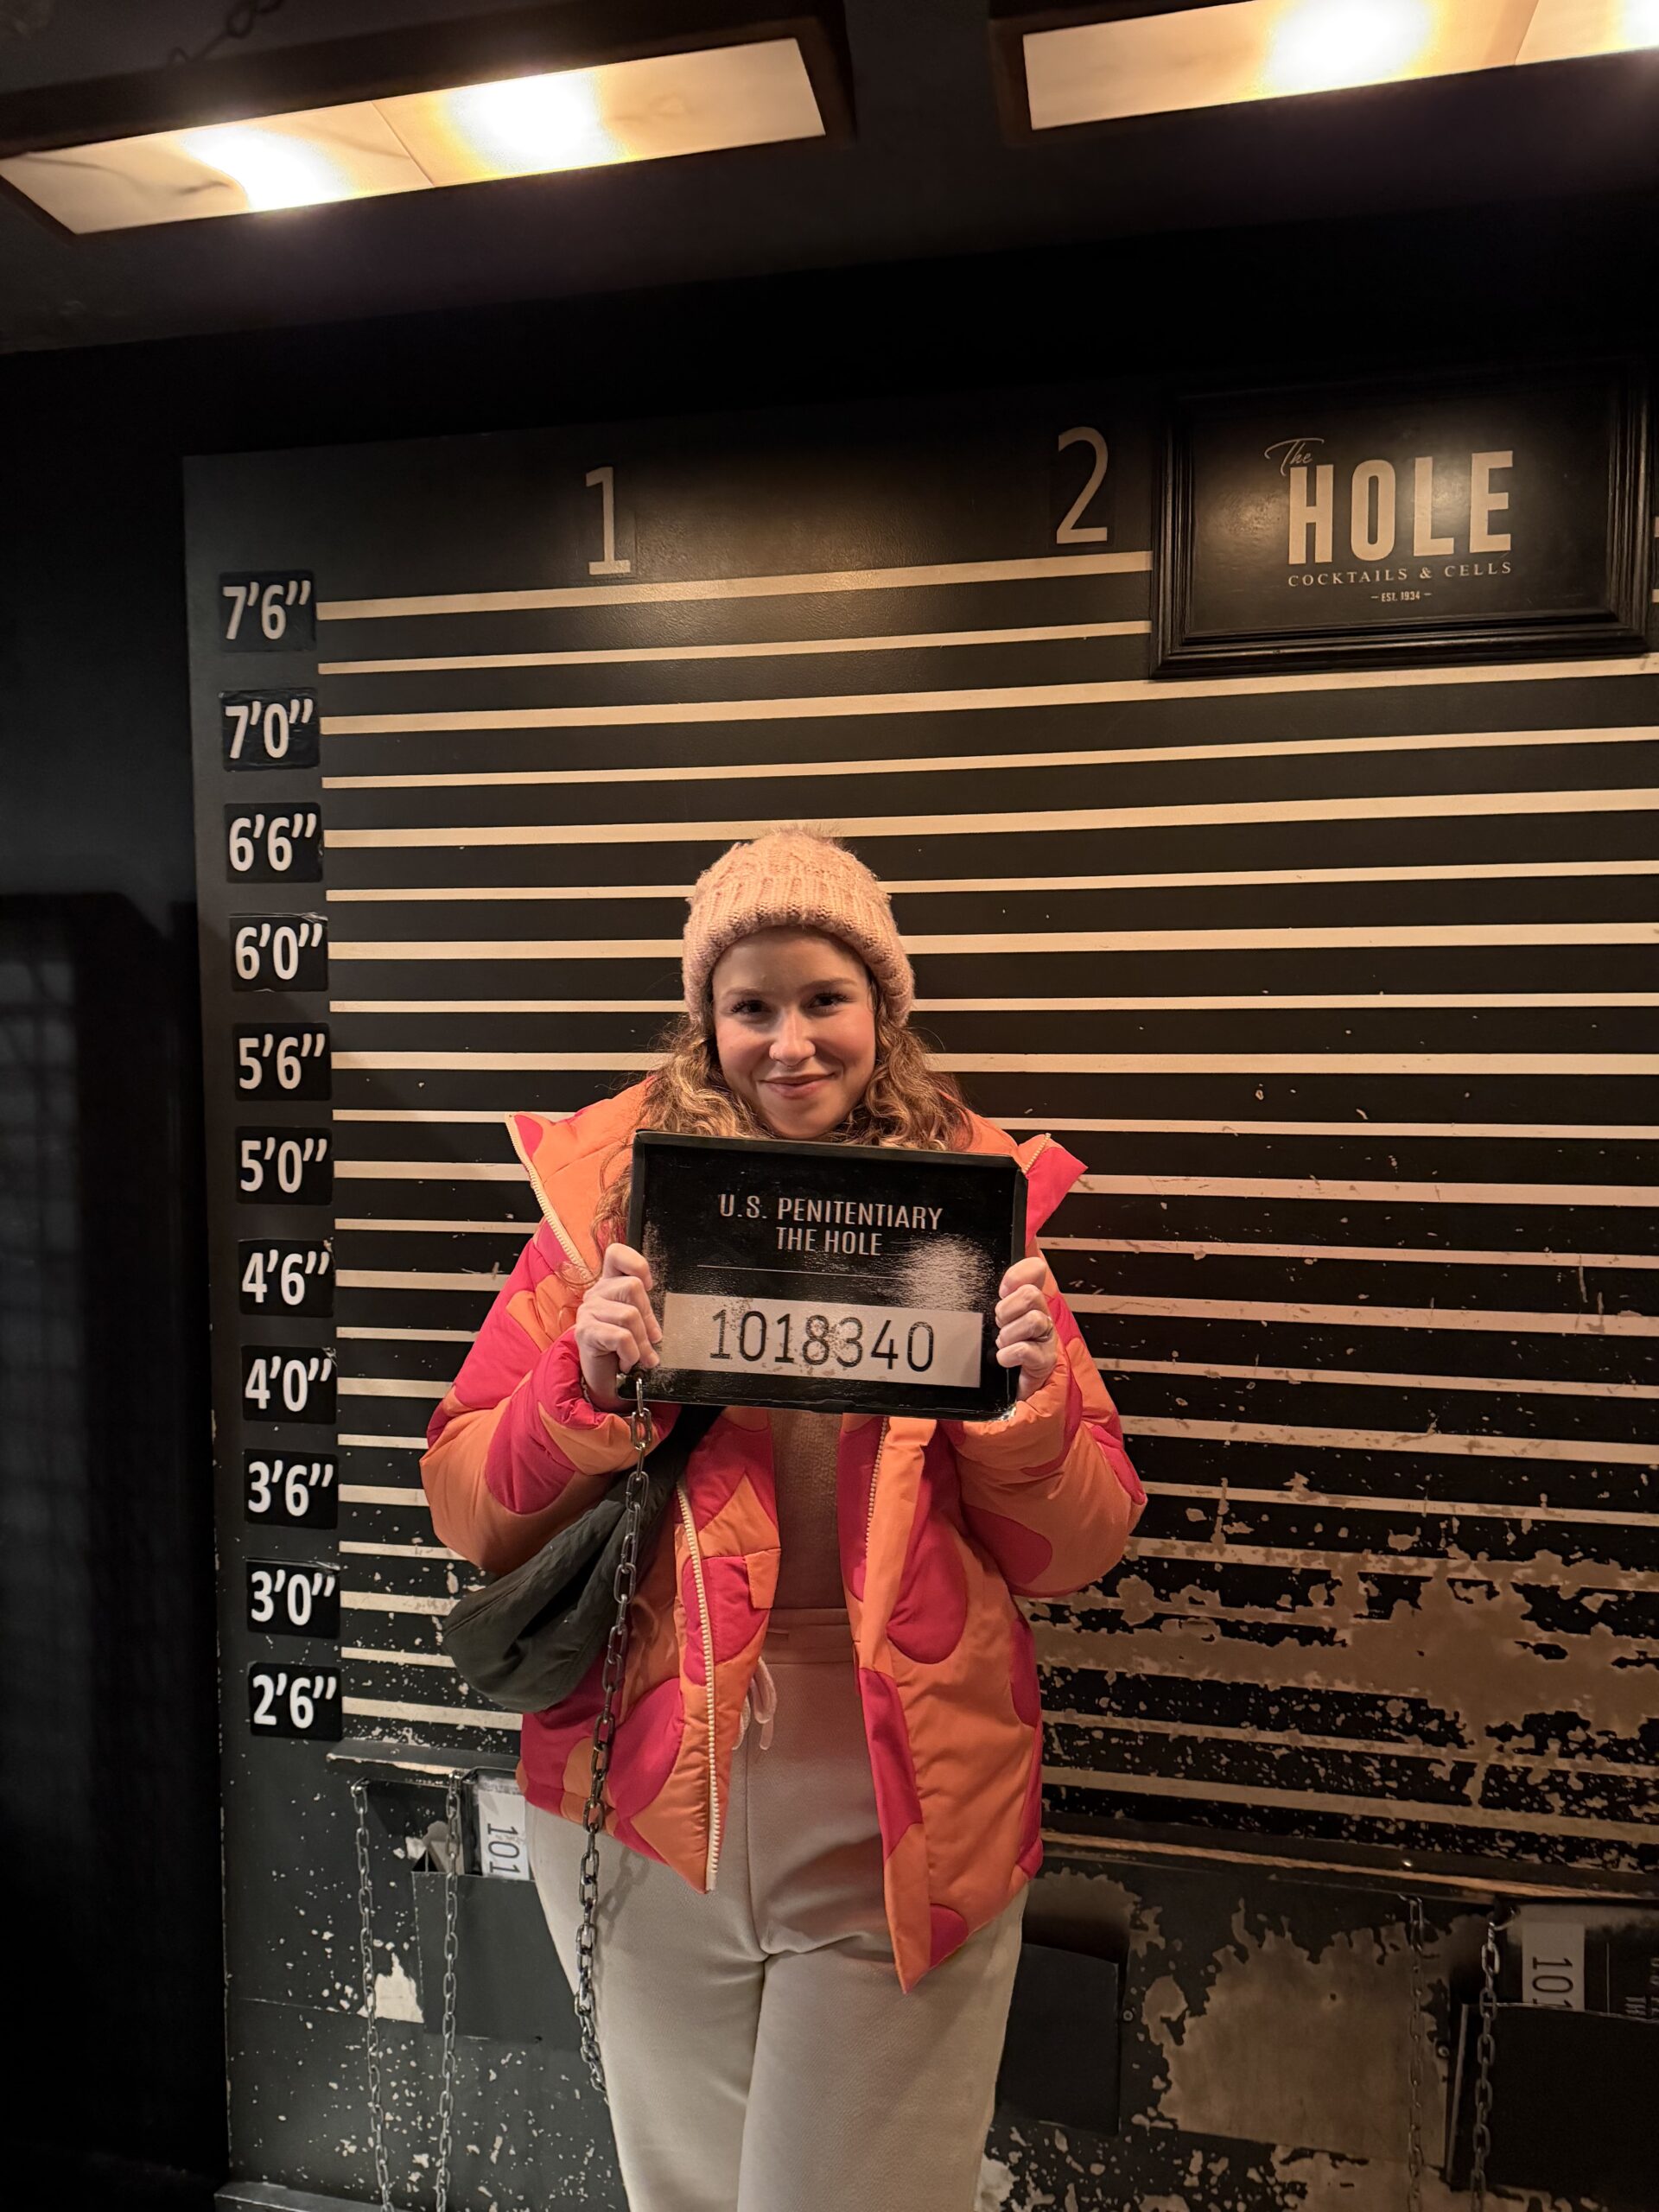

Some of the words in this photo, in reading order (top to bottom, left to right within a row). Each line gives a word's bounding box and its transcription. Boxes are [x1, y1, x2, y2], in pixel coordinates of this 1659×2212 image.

[1264, 437, 1325, 476] The
[585, 467, 631, 575] 1
[1056, 427, 1109, 544] 2
[1289, 451, 1512, 564] HOLE
[1287, 568, 1408, 588] COCKTAILS
[1419, 567, 1433, 579] &
[1444, 562, 1512, 578] CELLS
[1381, 593, 1398, 602] EST.
[1401, 591, 1421, 601] 1934
[718, 1193, 768, 1219] U.S.
[777, 1197, 944, 1230] PENITENTIARY
[776, 1226, 817, 1252] THE
[823, 1230, 882, 1256] HOLE
[709, 1309, 936, 1373] 1018340
[486, 1822, 521, 1874] 101
